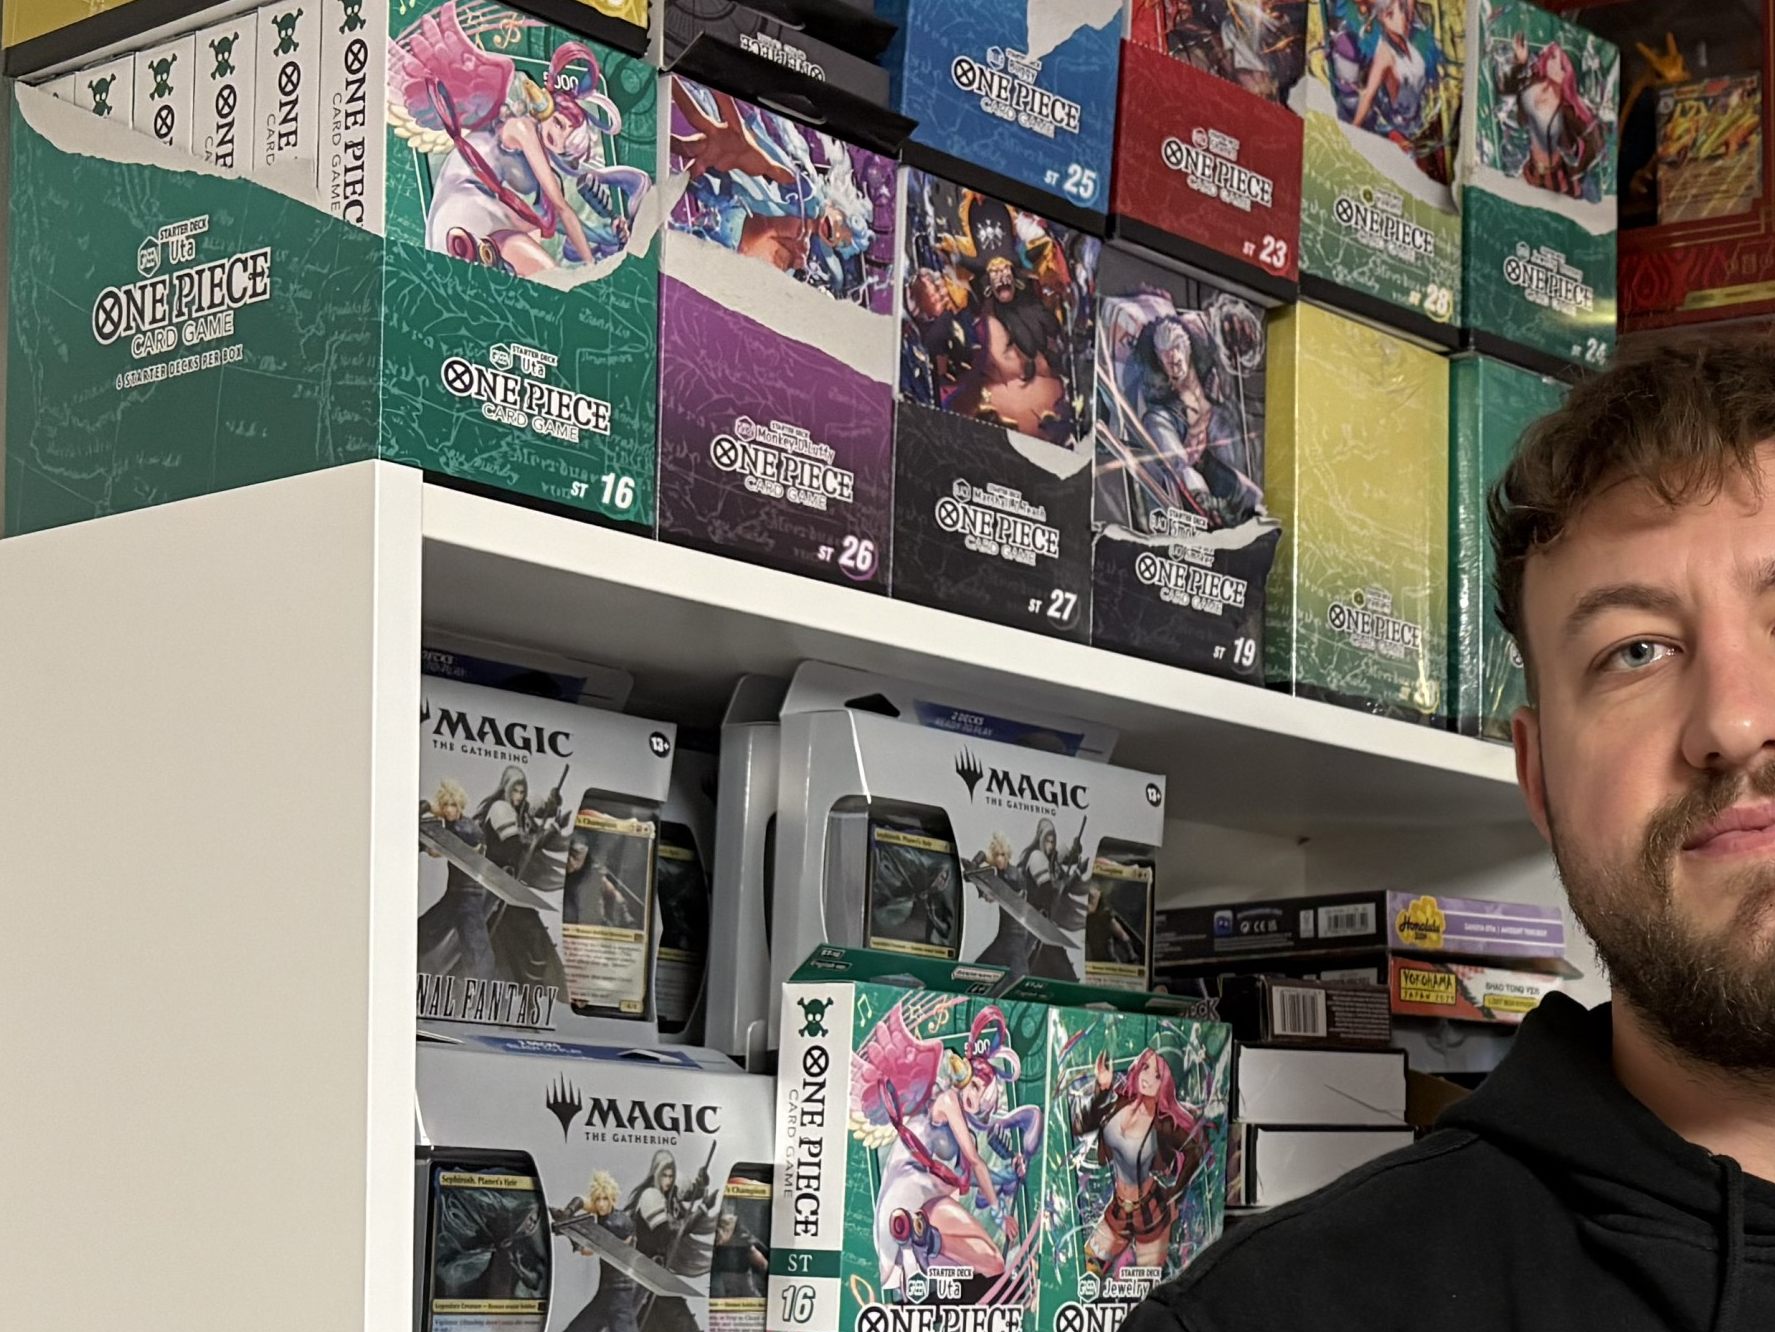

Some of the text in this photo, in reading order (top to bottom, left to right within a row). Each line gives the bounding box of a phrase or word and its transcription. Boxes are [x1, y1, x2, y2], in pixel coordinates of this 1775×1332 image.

[278, 61, 301, 151] ONE
[952, 55, 1081, 133] ONE PIECE
[266, 114, 275, 166] CARD
[343, 38, 368, 227] ONE PIEC
[330, 93, 341, 211] CARD GAME
[1044, 164, 1098, 198] ST 25
[1162, 137, 1215, 181] ONE
[1215, 159, 1273, 208] PIECE
[160, 217, 208, 240] STARTER DECK
[1335, 198, 1384, 235] ONE
[1383, 210, 1434, 256] PIECE
[170, 238, 195, 263] Uta
[1259, 235, 1287, 268] 23
[93, 276, 169, 344] ONE
[173, 248, 270, 322] PIECE
[1424, 283, 1450, 314] 28
[1504, 256, 1549, 294] ONE
[1547, 270, 1594, 312] PIECE
[132, 311, 234, 358] CARD GAME
[1585, 337, 1608, 366] 24
[115, 345, 243, 389] 6 STARTER DECKS PER BOX
[512, 345, 539, 360] STARTER
[540, 353, 557, 366] DECK
[521, 359, 545, 378] Uta
[442, 357, 520, 406] ONE
[525, 381, 611, 435] PIECE
[483, 403, 579, 443] CARD GAME
[711, 435, 854, 503] ONE PIECE
[571, 472, 635, 509] ST 16
[745, 476, 827, 510] CARD GAME
[935, 497, 1060, 558] ONE PIECE
[817, 535, 874, 571] ST 26
[1136, 552, 1247, 608] ONE PIECE
[1028, 589, 1077, 621] ST 27
[1328, 602, 1422, 651] ONE PIECE
[1213, 637, 1256, 667] ST 19
[432, 739, 529, 764] THE GATHERING
[433, 707, 574, 758] MAGIC
[650, 735, 671, 753] 13+
[986, 767, 1089, 810] MAGIC
[986, 797, 1056, 816] THE GATHERING
[1399, 918, 1440, 934] Honolulu
[1403, 971, 1453, 990] YOKOHAMA
[461, 978, 559, 1027] FANTASY
[585, 1097, 722, 1136] MAGIC
[585, 1131, 678, 1146] THE GATHERING
[783, 1089, 800, 1198] CARD GAME
[793, 1045, 830, 1238] ONE PIECE
[788, 1254, 813, 1272] ST
[929, 1268, 973, 1279] STARTER DECK
[1121, 1269, 1161, 1278] STARTER DECK
[782, 1284, 816, 1324] 16
[937, 1279, 961, 1299] Uta
[1103, 1279, 1149, 1300] Jewelry
